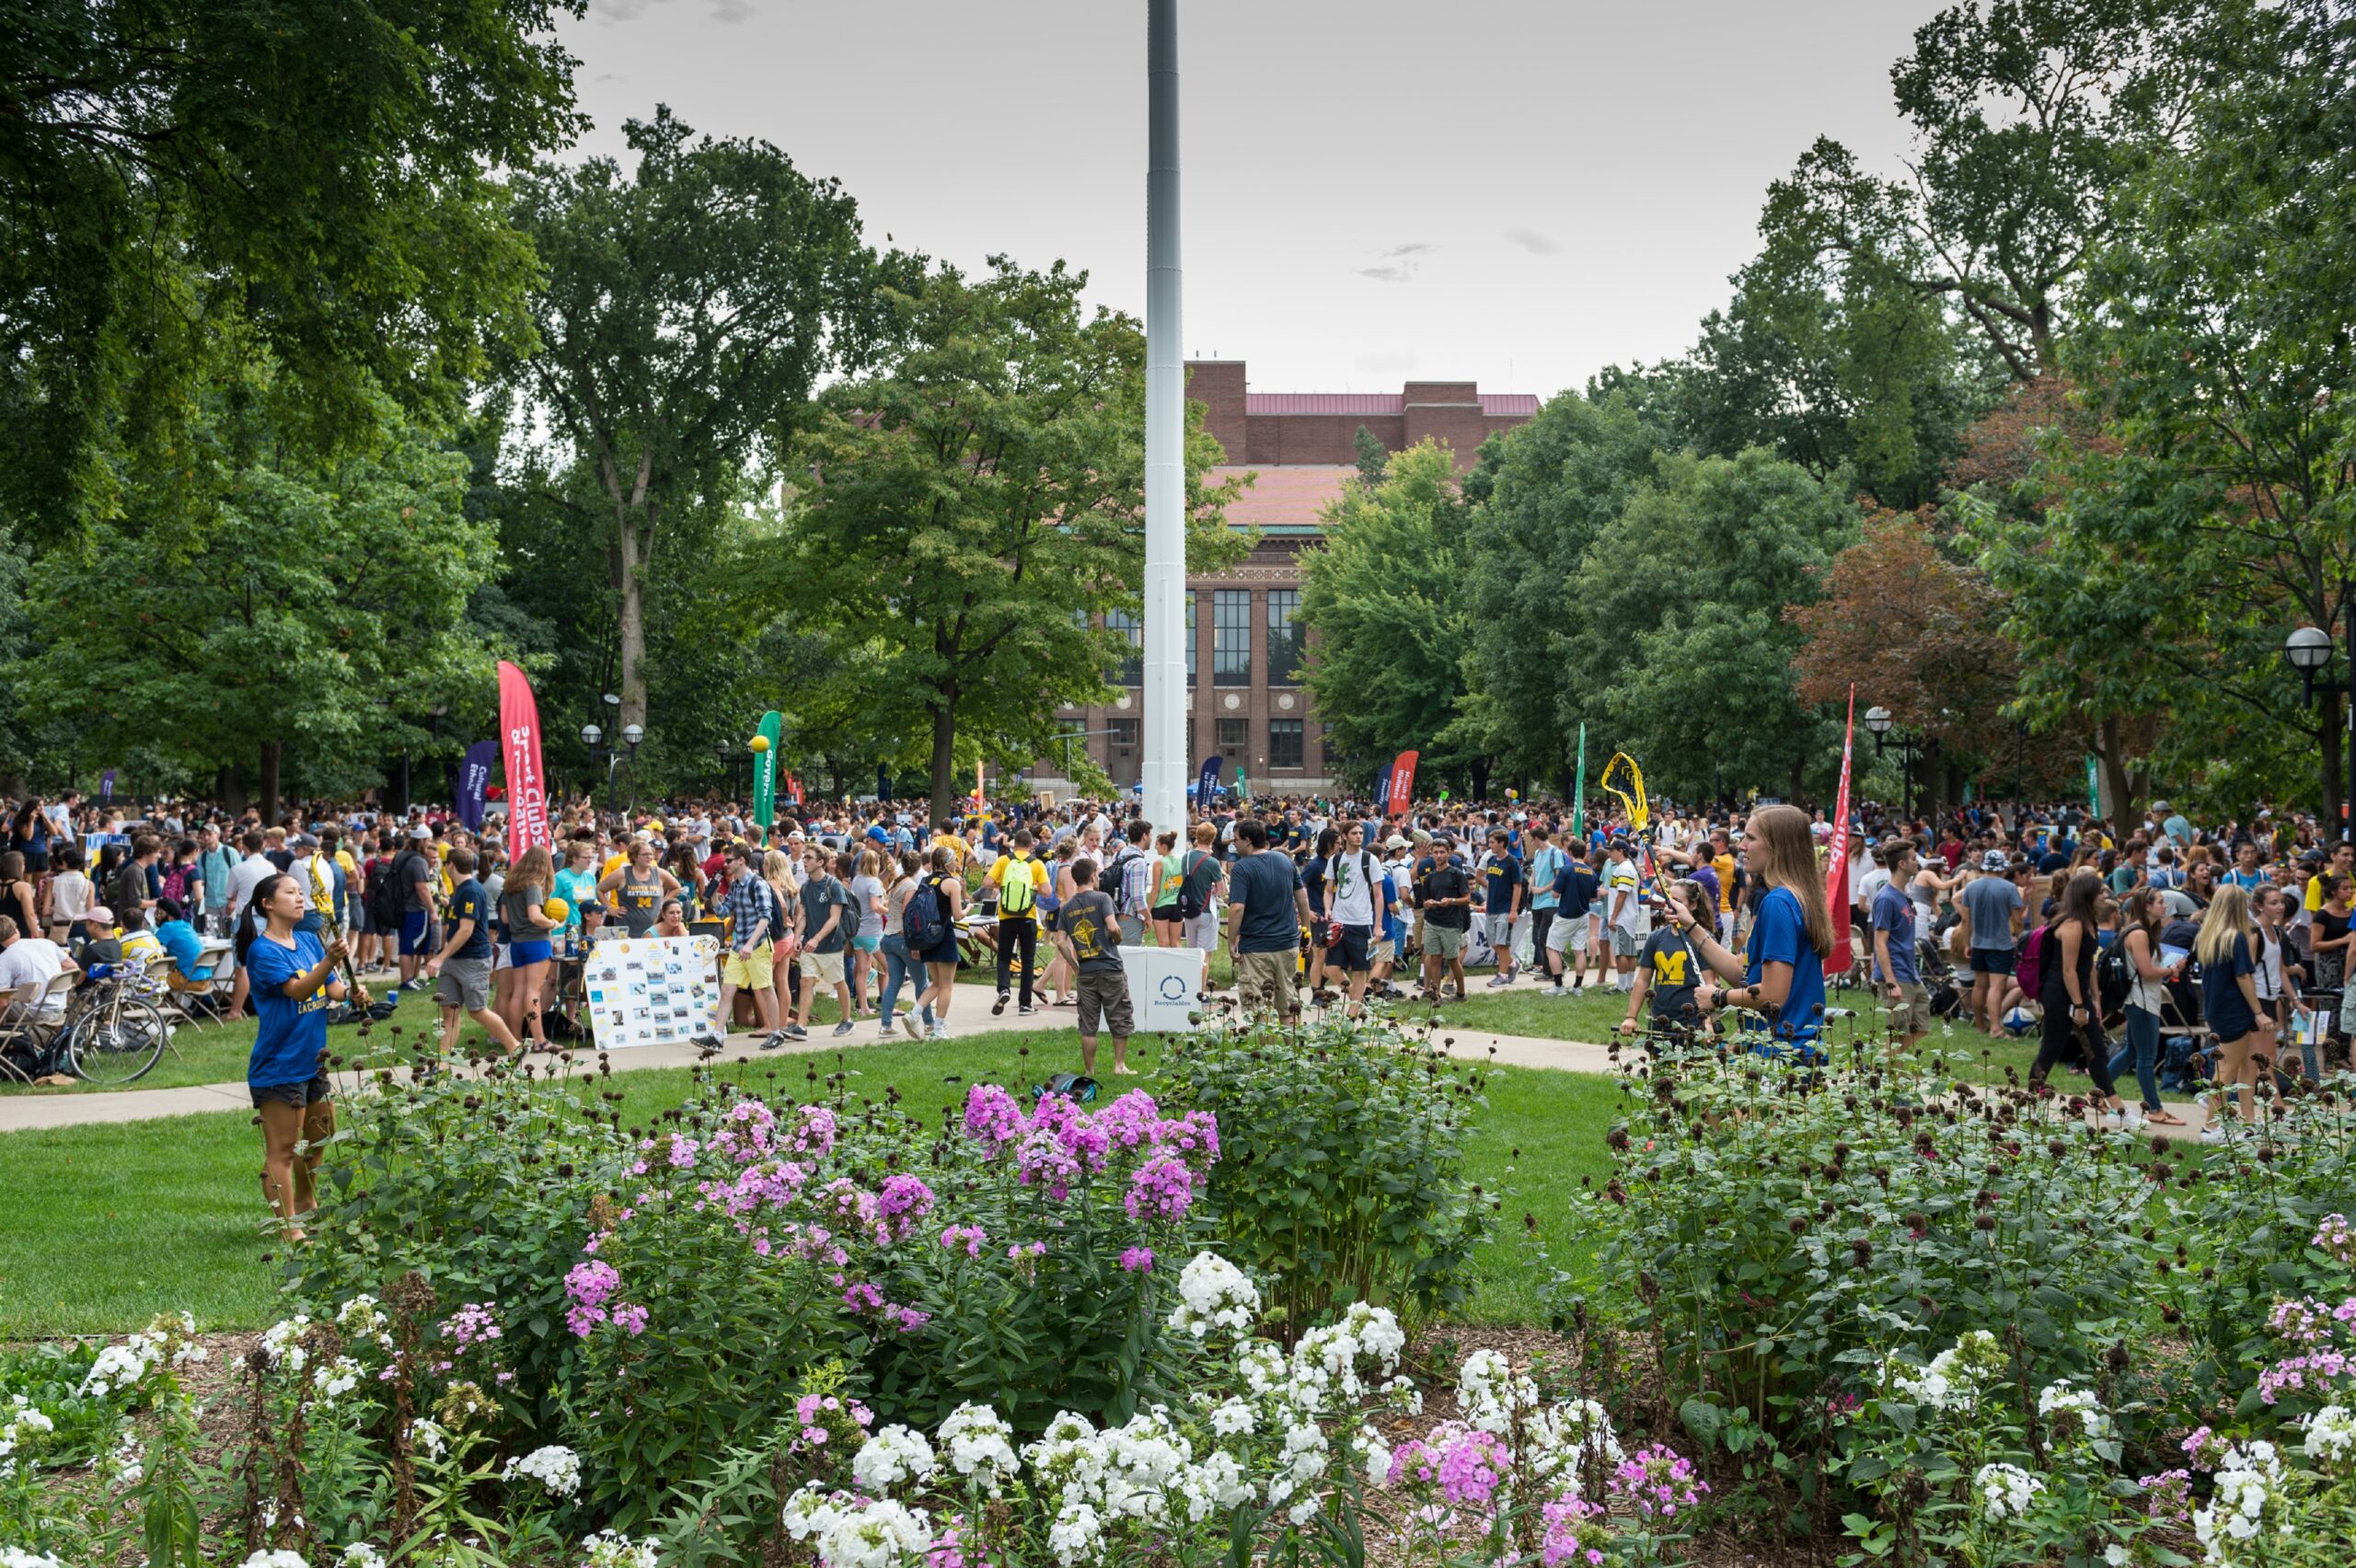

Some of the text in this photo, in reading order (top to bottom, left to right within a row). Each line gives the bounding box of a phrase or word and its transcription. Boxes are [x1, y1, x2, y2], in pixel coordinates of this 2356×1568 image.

[511, 728, 521, 745] &
[466, 763, 479, 790] Ethnic
[472, 766, 487, 801] Cultural
[521, 725, 547, 847] Sport Clubs
[1392, 769, 1404, 799] Wellness
[637, 896, 652, 907] M
[1654, 951, 1687, 980] M
[298, 998, 327, 1014] LACROSS
